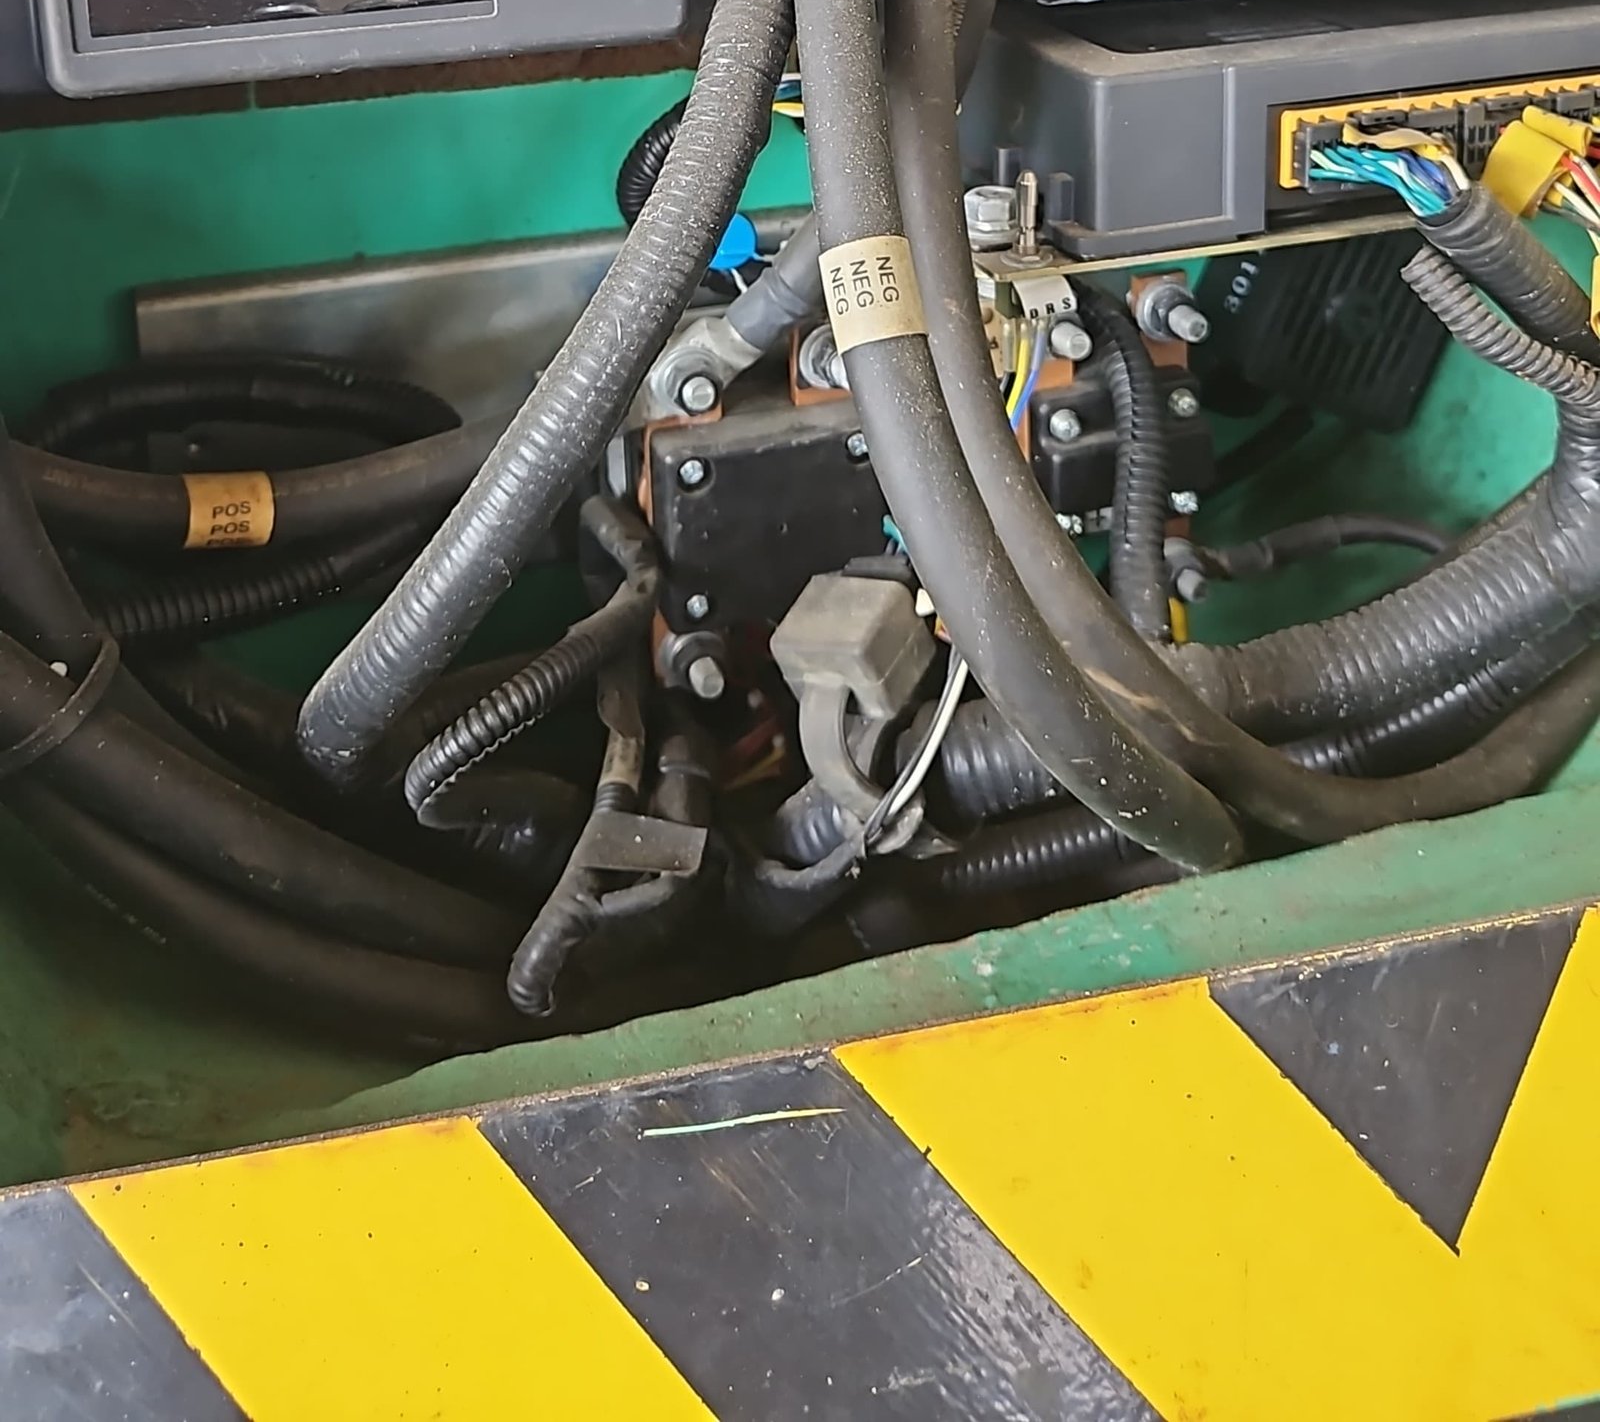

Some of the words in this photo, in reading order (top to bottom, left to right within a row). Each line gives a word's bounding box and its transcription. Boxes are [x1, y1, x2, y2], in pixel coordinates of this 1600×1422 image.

[830, 266, 849, 315] NEG
[850, 259, 874, 308] NEG
[876, 256, 900, 303] NEG
[210, 520, 250, 535] POS
[212, 500, 251, 519] POS
